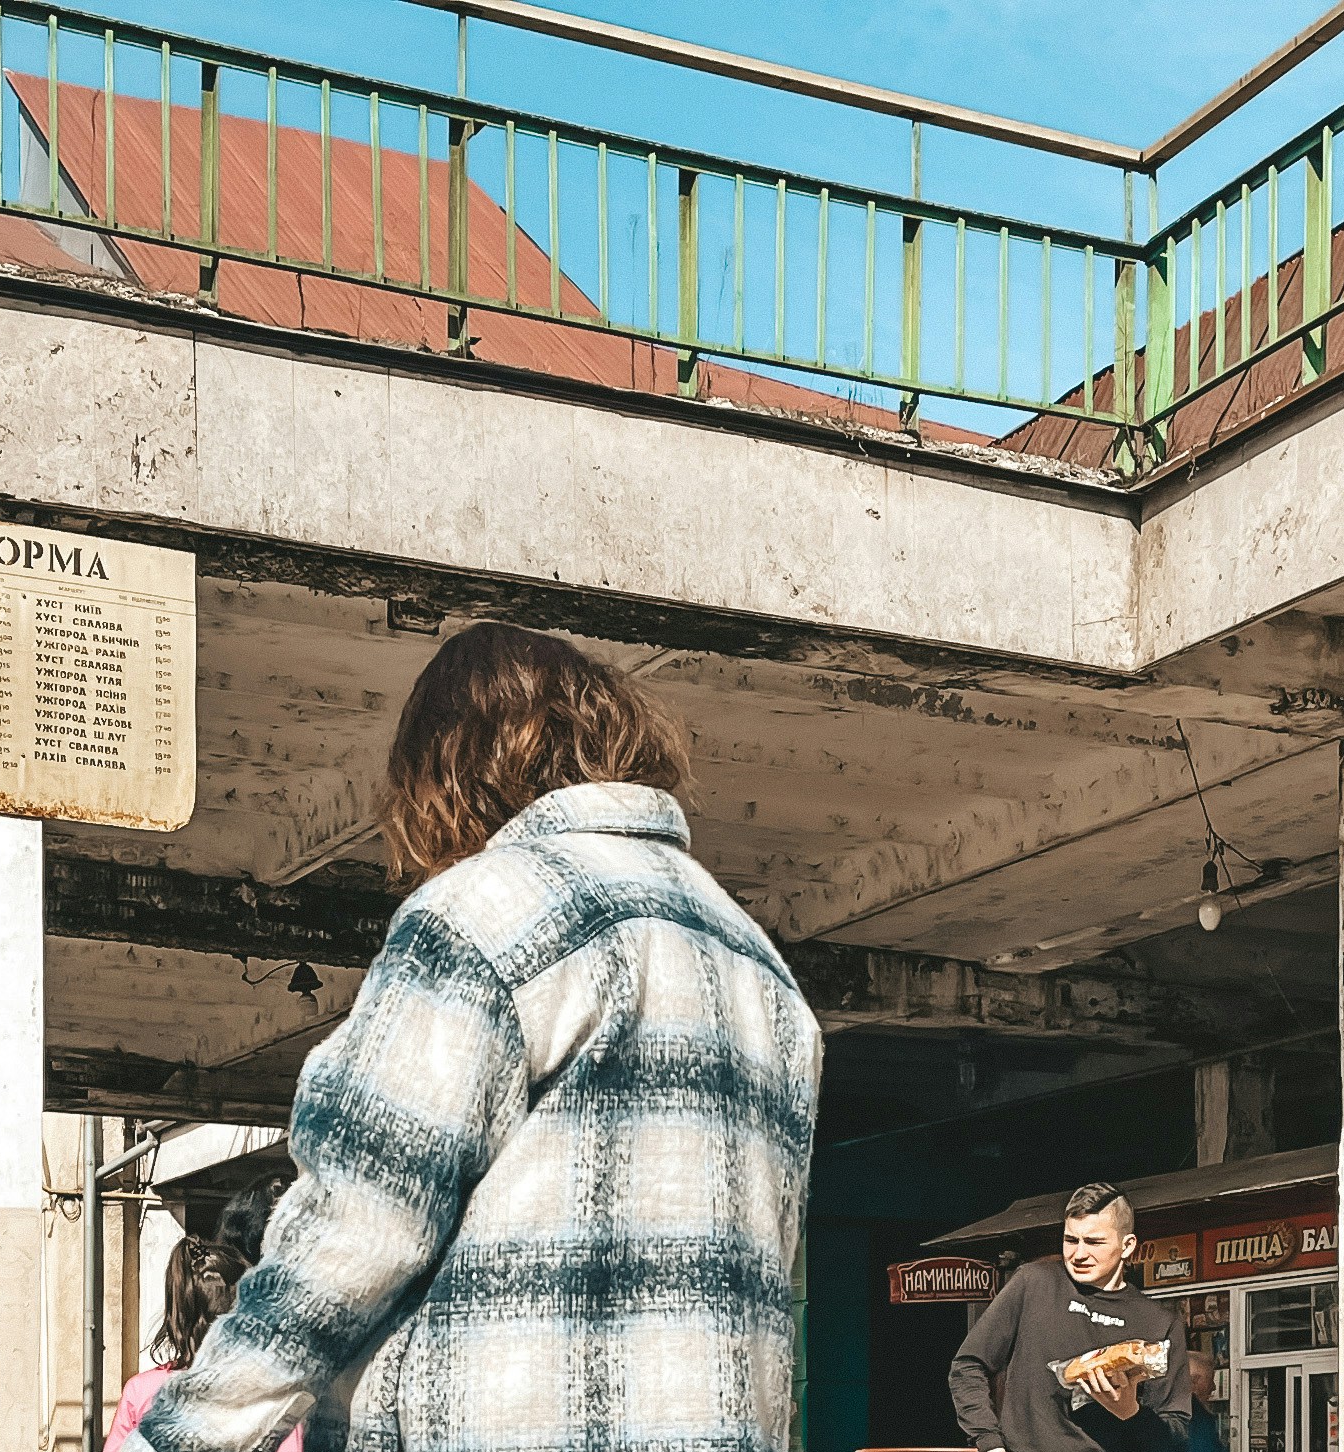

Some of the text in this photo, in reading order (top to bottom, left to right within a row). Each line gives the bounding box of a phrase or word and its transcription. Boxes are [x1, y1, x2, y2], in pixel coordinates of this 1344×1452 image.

[36, 599, 63, 610] ХУСТ
[75, 604, 101, 615] КИЇВ
[36, 612, 62, 623] ХУСТ
[73, 618, 122, 631] СВАЛЯВА
[35, 626, 87, 641] УЖГОРОД
[36, 640, 89, 655] УЖГОРОД
[96, 649, 126, 659] РАХІВ
[36, 653, 64, 665] ХУСТ
[74, 659, 122, 672] СВАЛЯВА
[36, 667, 87, 682] УЖГОРОД
[96, 675, 122, 686] УГЛЯ
[36, 681, 86, 696] УЖГОРОД
[96, 690, 127, 701] ЯСІНЯ
[35, 695, 86, 710] УЖГОРОД
[96, 703, 126, 714] РАХІВ
[35, 709, 86, 724] УЖГОРОД
[93, 717, 132, 729] ДУБОВЕ
[35, 723, 87, 738] УЖГОРОД
[35, 737, 61, 748] ХУСТ
[69, 742, 118, 756] СВАЛЯВА
[35, 751, 66, 762] РАХІВ
[76, 756, 126, 770] СВАЛЯВА
[1215, 1234, 1282, 1263] ПІЦЦА
[905, 1262, 989, 1291] НАМИНАЙКО
